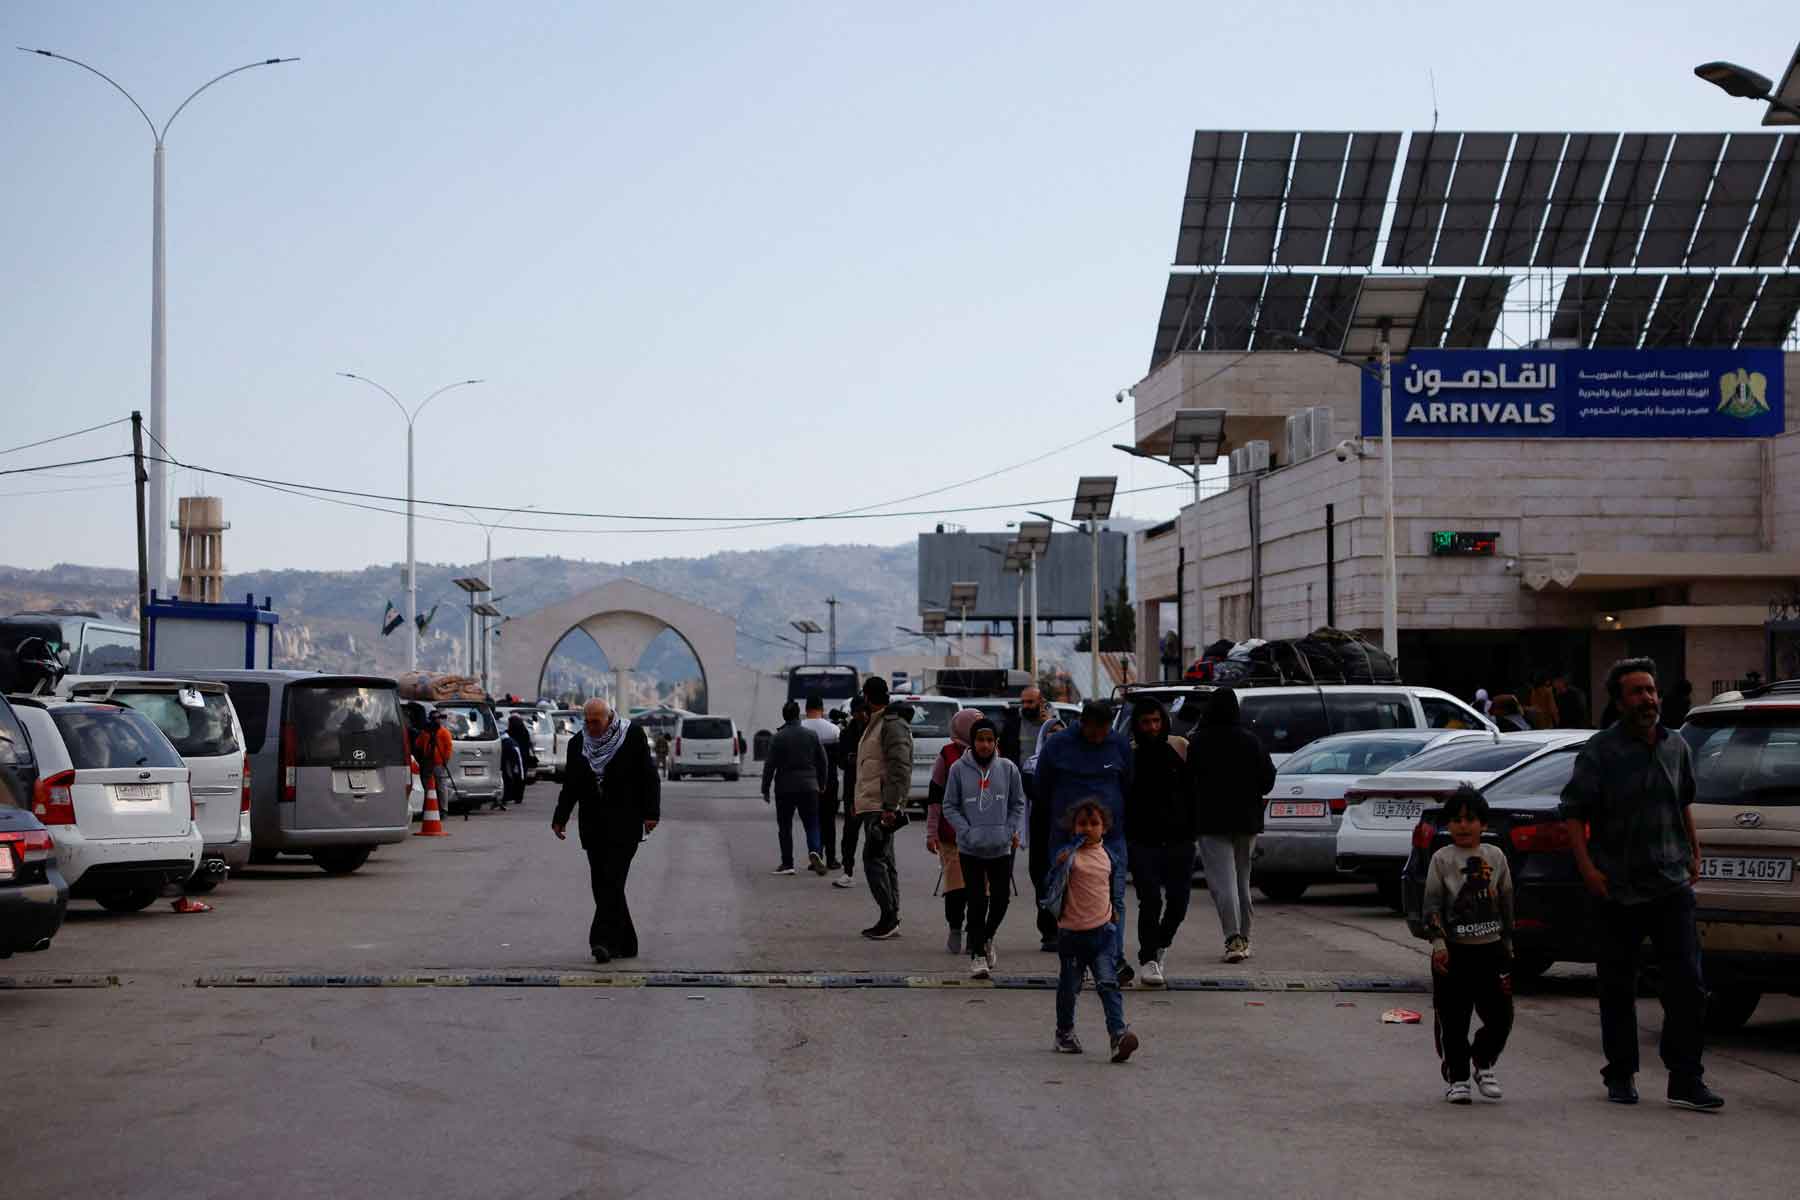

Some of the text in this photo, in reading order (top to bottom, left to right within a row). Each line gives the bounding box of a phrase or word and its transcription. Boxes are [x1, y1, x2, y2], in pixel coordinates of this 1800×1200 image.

[1405, 363, 1556, 396] القادمون
[1404, 402, 1556, 424] ARRIVALS
[1699, 859, 1717, 876] 15
[1738, 860, 1786, 878] 14057
